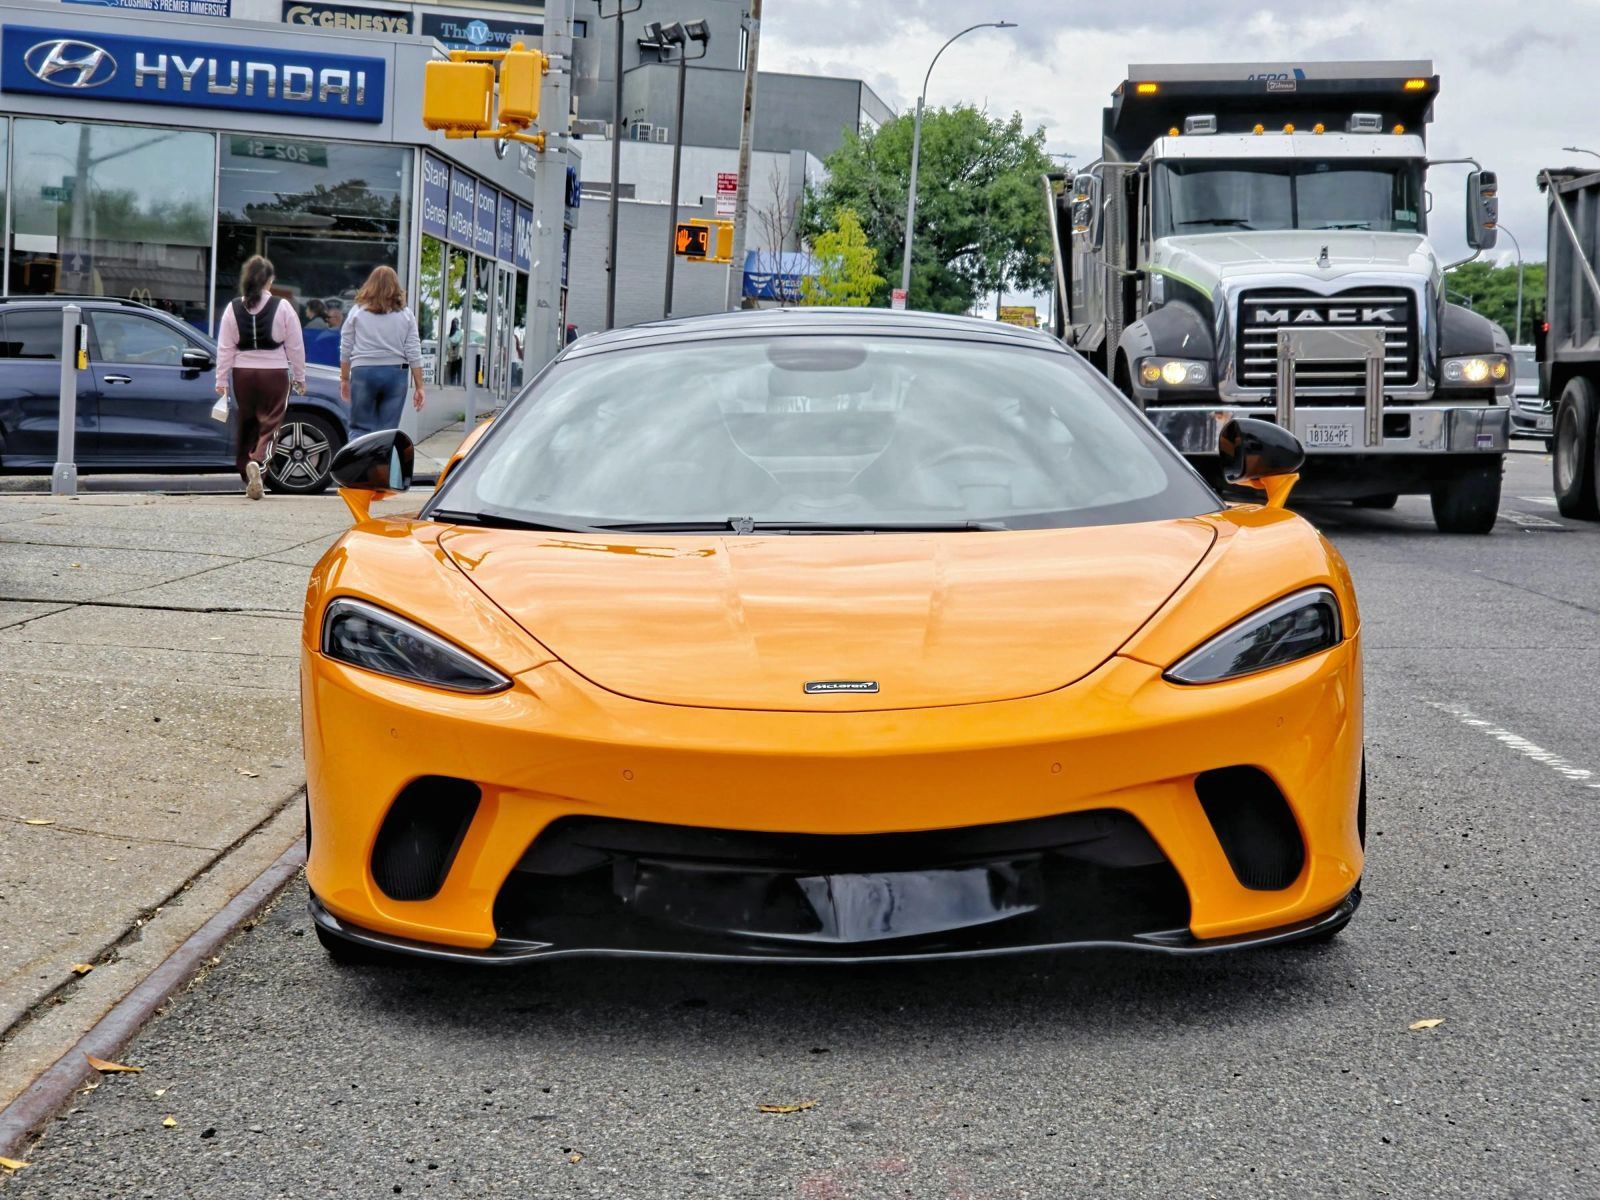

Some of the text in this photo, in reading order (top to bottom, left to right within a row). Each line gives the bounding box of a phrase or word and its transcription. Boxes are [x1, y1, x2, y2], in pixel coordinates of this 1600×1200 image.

[160, 0, 189, 12] PREMIER
[190, 1, 227, 16] IMMERSIVE
[320, 11, 408, 34] GENESYS
[136, 52, 366, 106] HYUNDAI
[699, 232, 707, 251] 9
[1256, 308, 1396, 322] MACK
[811, 682, 871, 690] McLaren
